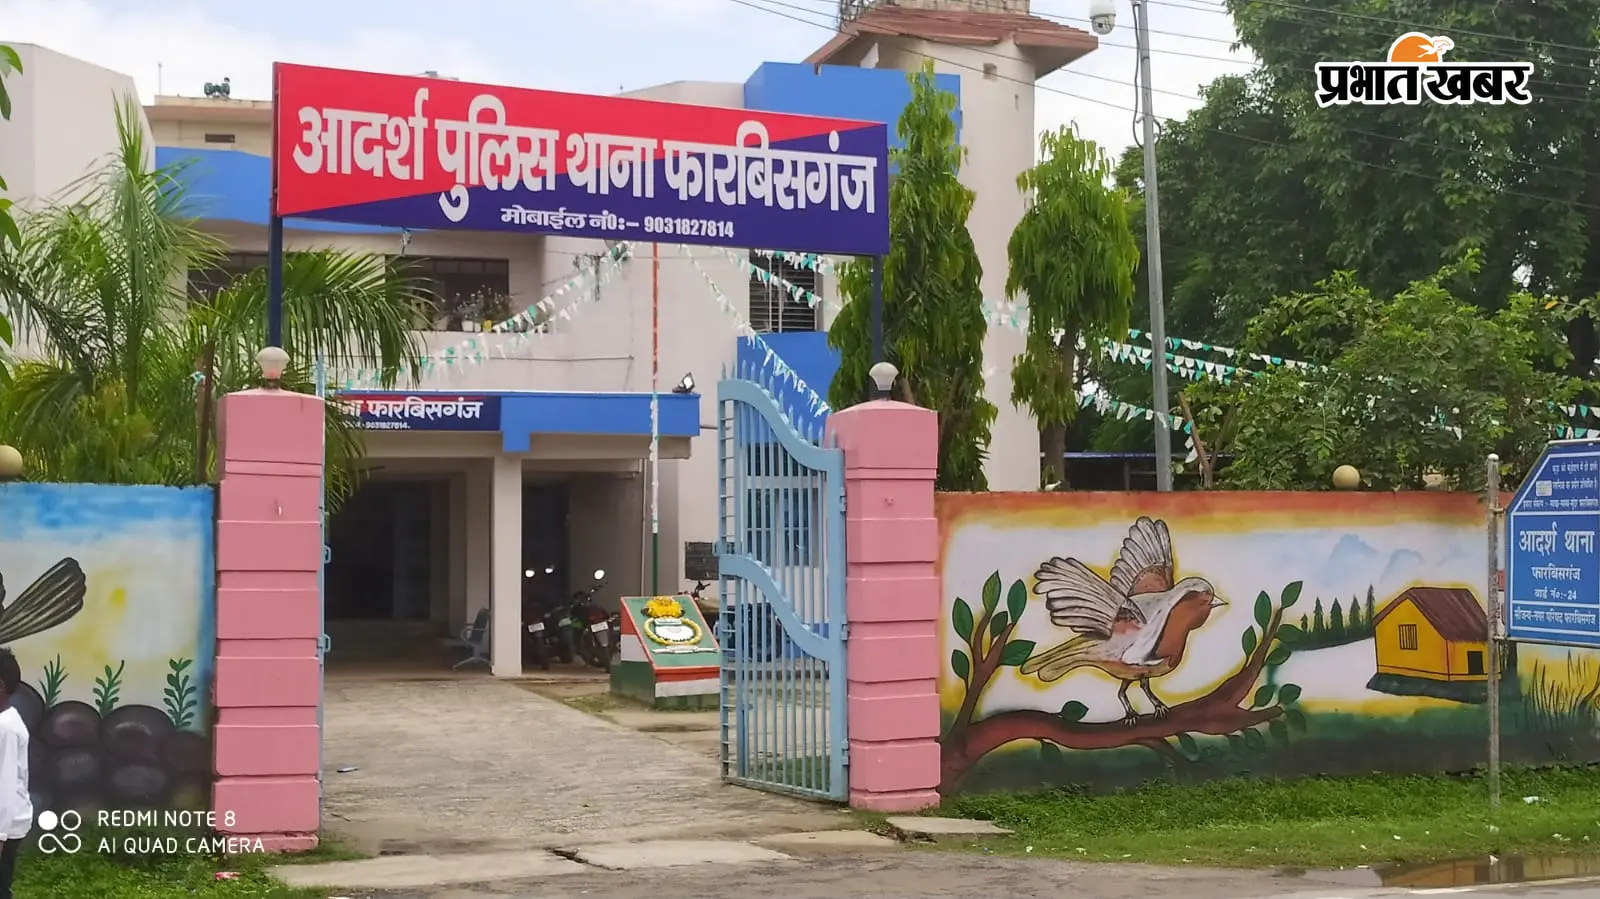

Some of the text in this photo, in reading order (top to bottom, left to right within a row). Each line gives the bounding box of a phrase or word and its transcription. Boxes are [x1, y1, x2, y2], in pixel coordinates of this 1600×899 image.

[292, 87, 878, 223] आदर्श पुलिस थाना फारबिसगंज
[500, 204, 587, 230] मोबाईल
[643, 215, 735, 239] 9031827814
[366, 395, 484, 421] फारबिसगंज
[1518, 520, 1595, 557] आदर्श थाना
[1531, 562, 1582, 581] फारबिसगंज
